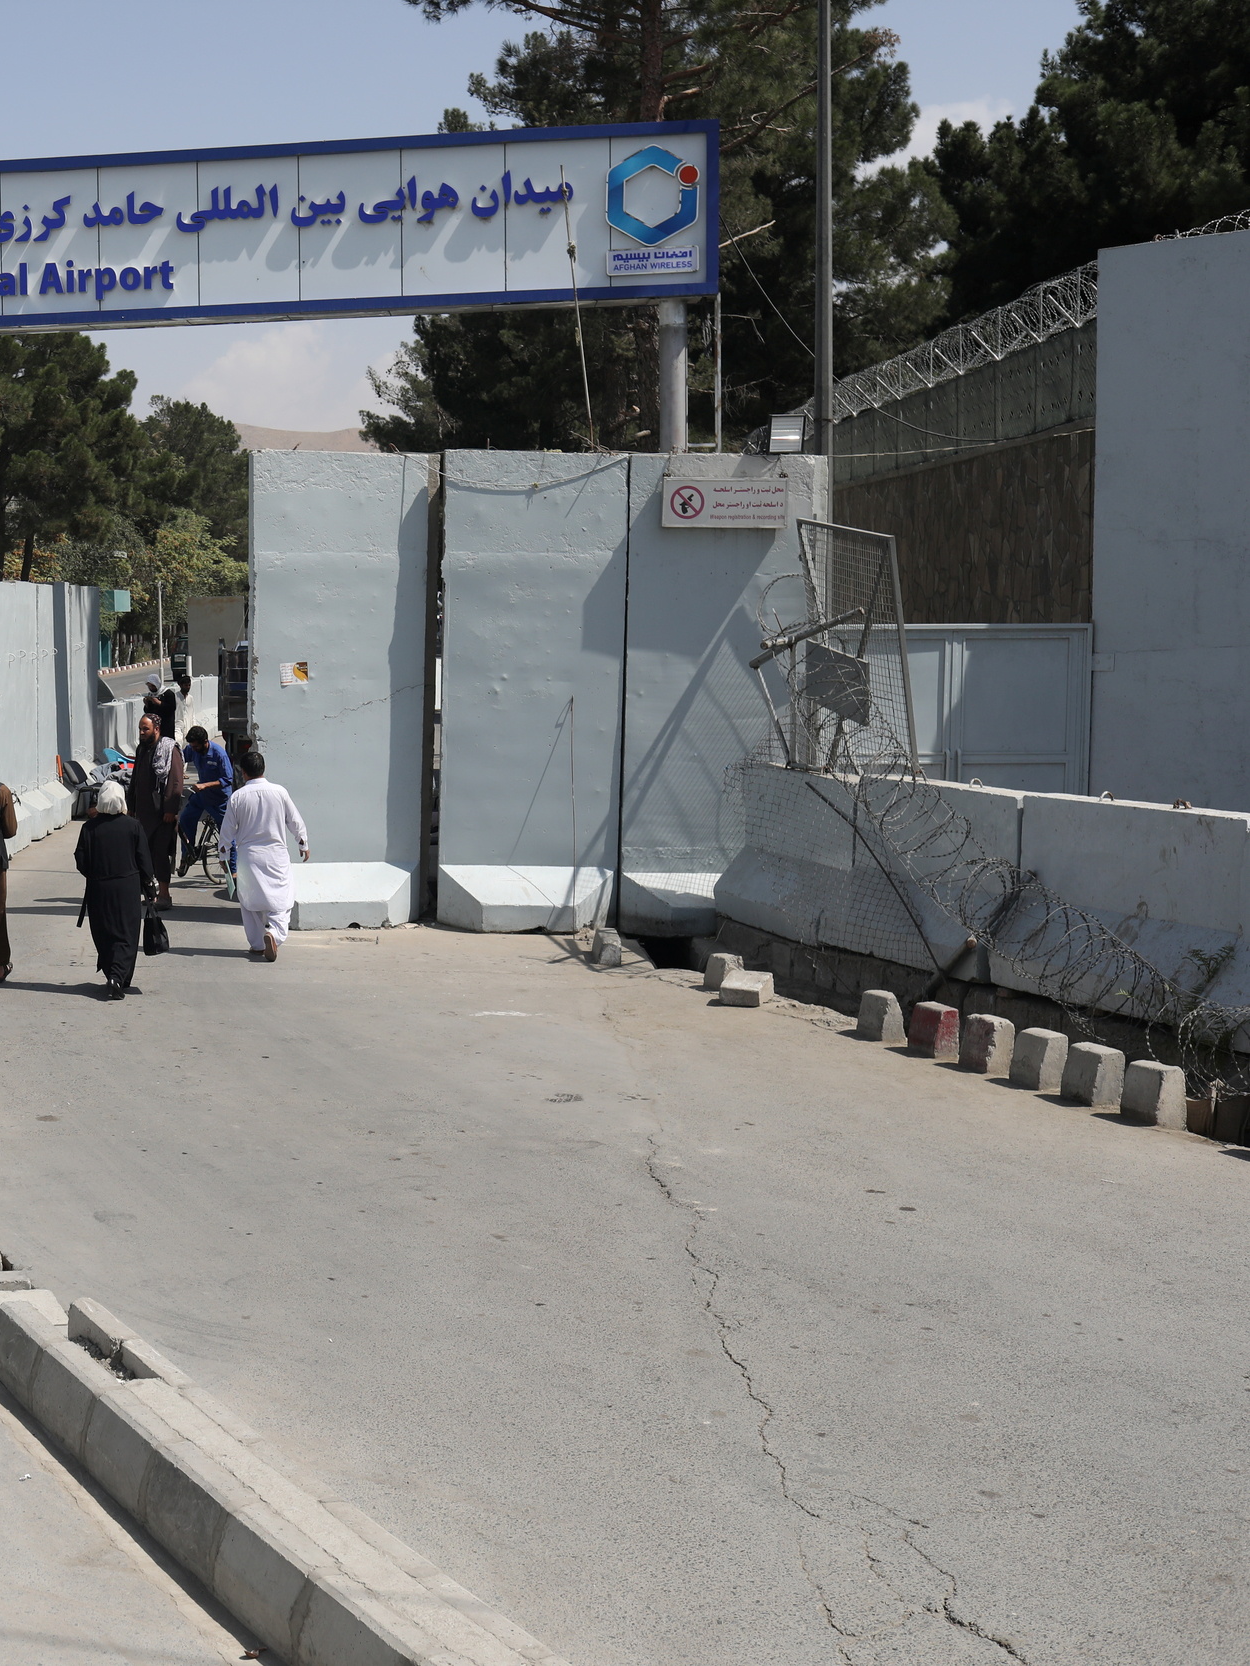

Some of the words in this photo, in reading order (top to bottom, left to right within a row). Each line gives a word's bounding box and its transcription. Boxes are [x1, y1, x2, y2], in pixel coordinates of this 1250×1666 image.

[83, 191, 165, 228] حامد
[175, 184, 280, 233] المللی
[290, 190, 347, 228] بین
[358, 176, 460, 225] هوایی
[471, 171, 575, 219] میدان
[39, 259, 175, 301] Airport
[613, 263, 648, 271] AFGHAN
[650, 260, 693, 269] WIRELESS
